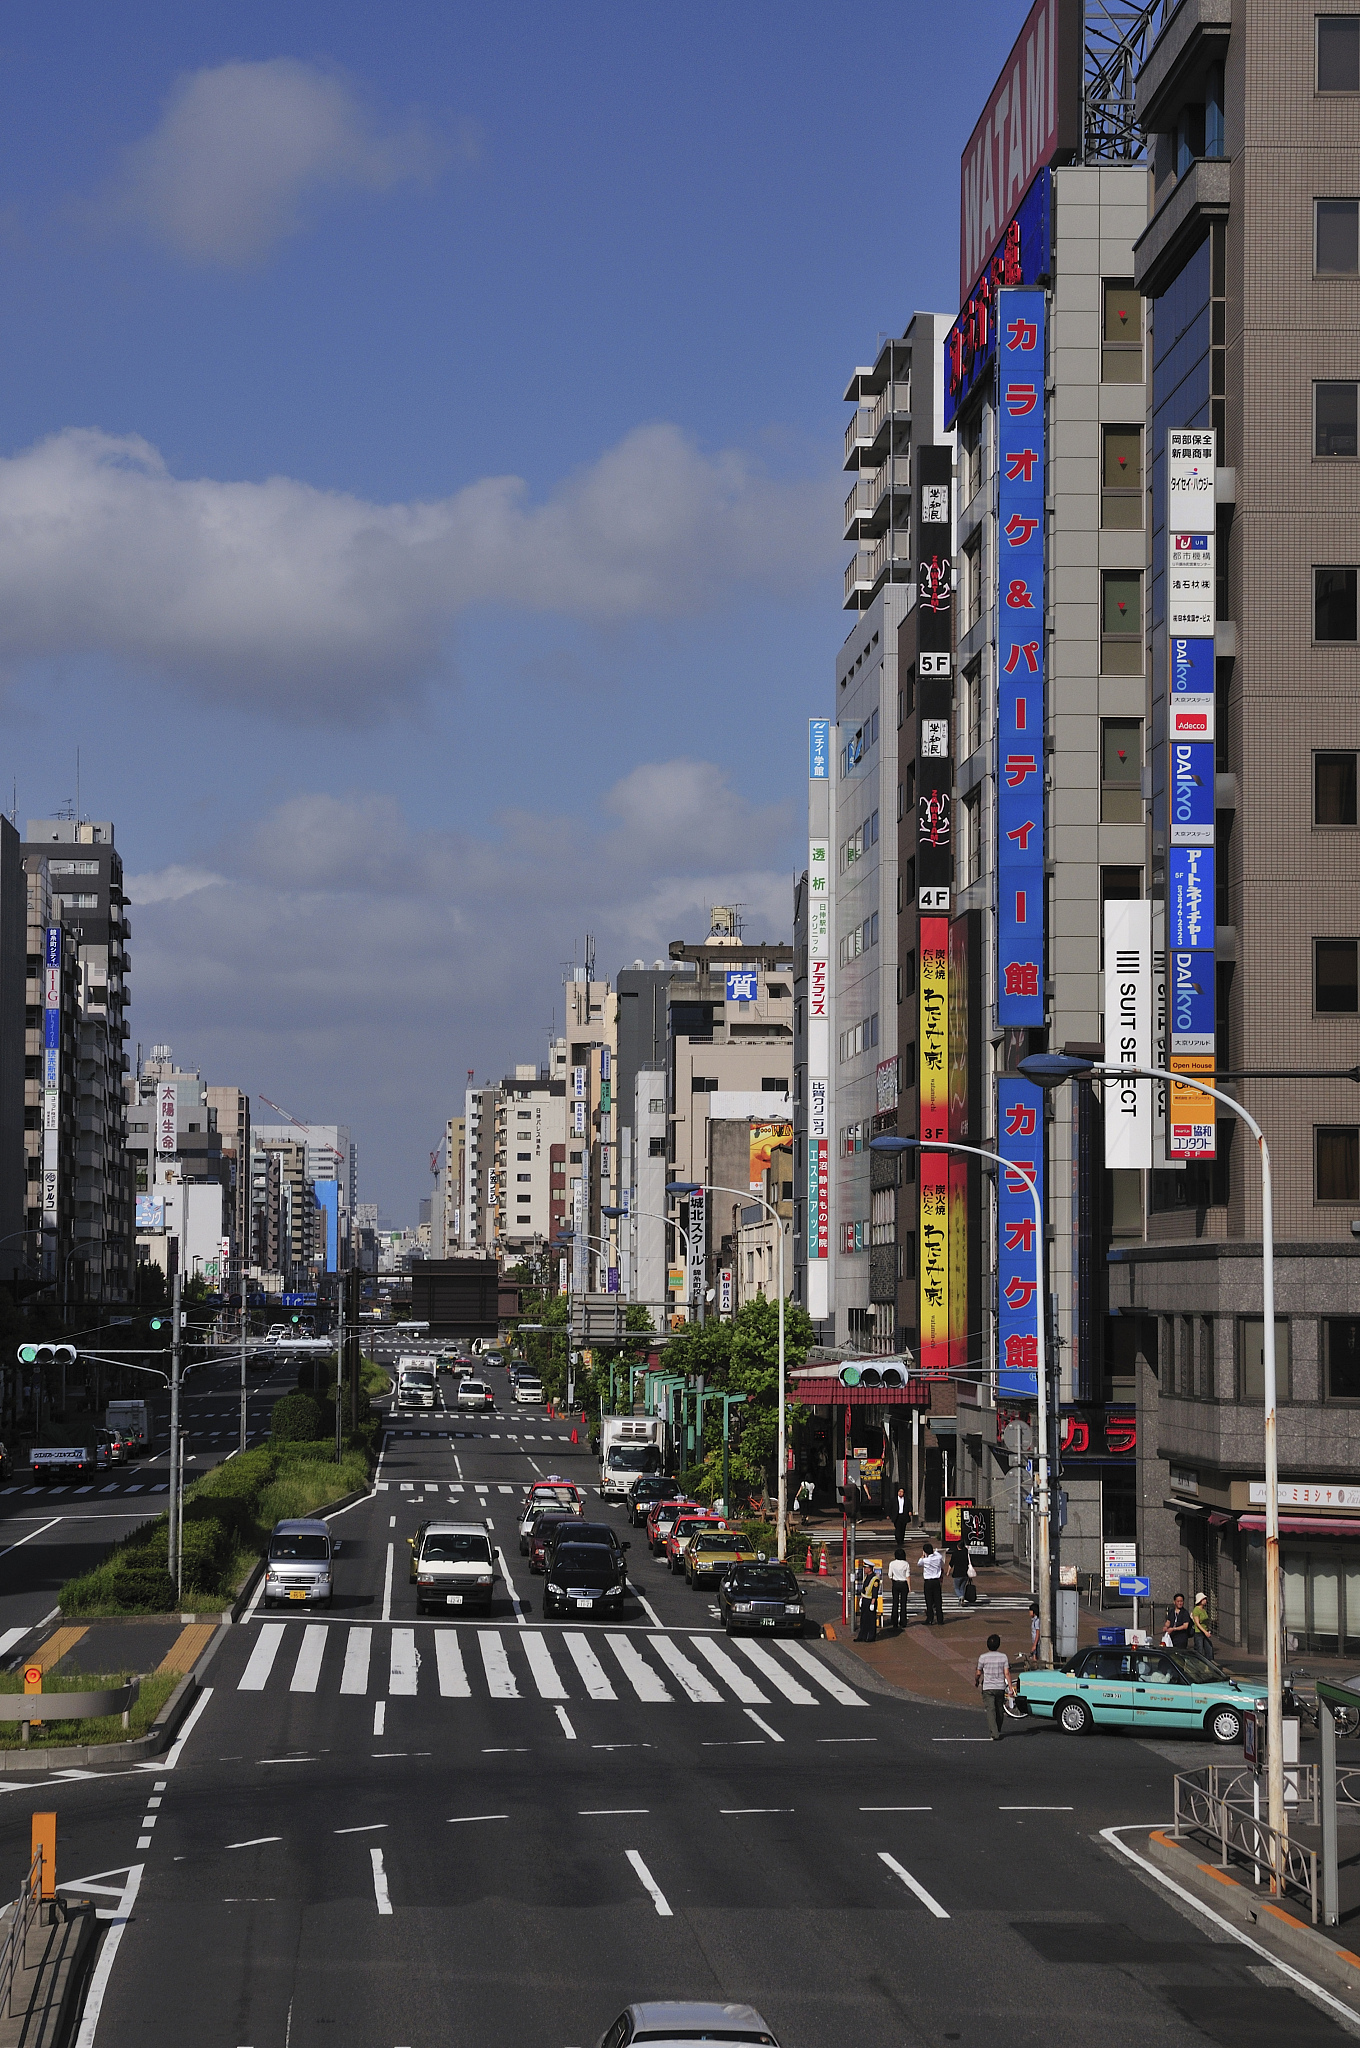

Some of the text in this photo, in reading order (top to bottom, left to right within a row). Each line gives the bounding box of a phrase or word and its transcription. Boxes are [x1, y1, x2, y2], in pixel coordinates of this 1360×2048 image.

[963, 0, 1055, 285] WATAMI
[1172, 434, 1212, 445] 岡部保全
[1172, 448, 1212, 459] 新興商事
[1173, 552, 1211, 560] 都市機構
[921, 657, 948, 671] 5F
[1178, 722, 1205, 730] Adecco
[813, 731, 824, 776] ニチイ学館
[812, 848, 826, 891] 透析
[920, 891, 947, 906] 4F
[923, 949, 933, 980] だいにんぐ
[935, 949, 945, 980] 炭火焼
[727, 973, 757, 999] 質
[811, 962, 826, 1015] アデランス
[1120, 983, 1136, 1117] SUIT SEECT
[162, 1086, 175, 1150] 太陽生命
[925, 1128, 944, 1138] 3F
[1193, 1125, 1211, 1136] 協和
[1173, 1138, 1211, 1149] コンタクト
[46, 1185, 55, 1208] マルコ
[810, 1150, 818, 1248] エステアップ
[923, 1184, 933, 1216] だいにんぐ
[935, 1184, 945, 1216] 炭火焼
[690, 1197, 704, 1266] 城北スクール
[1004, 1104, 1038, 1368] カラオケ館
